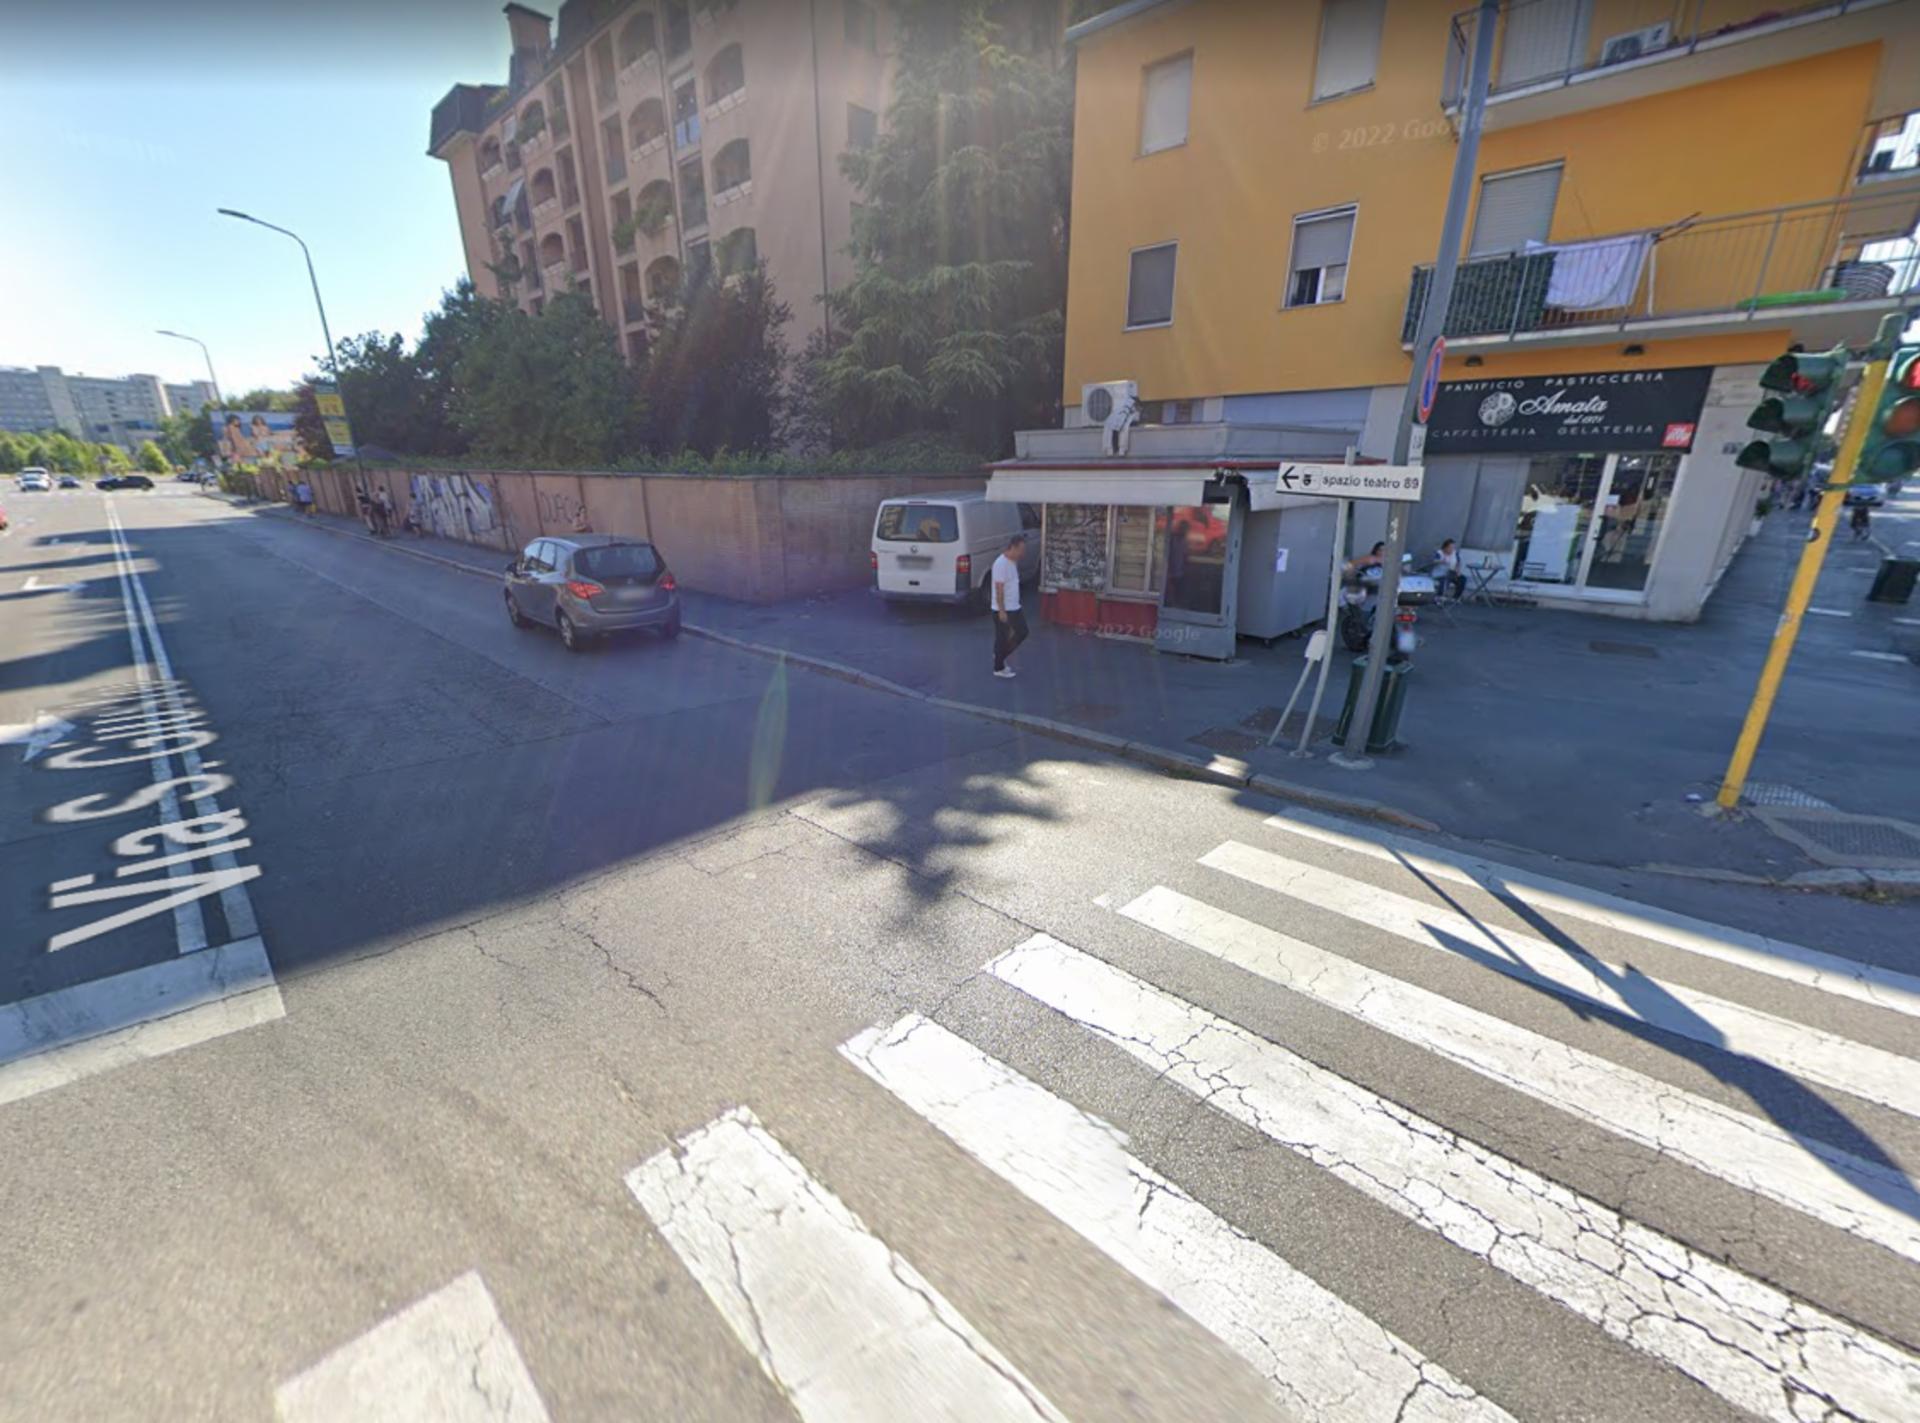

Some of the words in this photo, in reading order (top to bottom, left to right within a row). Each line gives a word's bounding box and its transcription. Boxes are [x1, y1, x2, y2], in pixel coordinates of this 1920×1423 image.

[1444, 380, 1525, 392] PANIFICIO
[1544, 372, 1664, 387] PASTICCERIA
[1518, 389, 1609, 416] Amata
[1432, 426, 1537, 438] CAFFETTERIA
[1557, 424, 1654, 436] GELATERIA
[1322, 475, 1360, 487] spazio
[1364, 477, 1400, 488] teatro
[1403, 478, 1420, 489] 89
